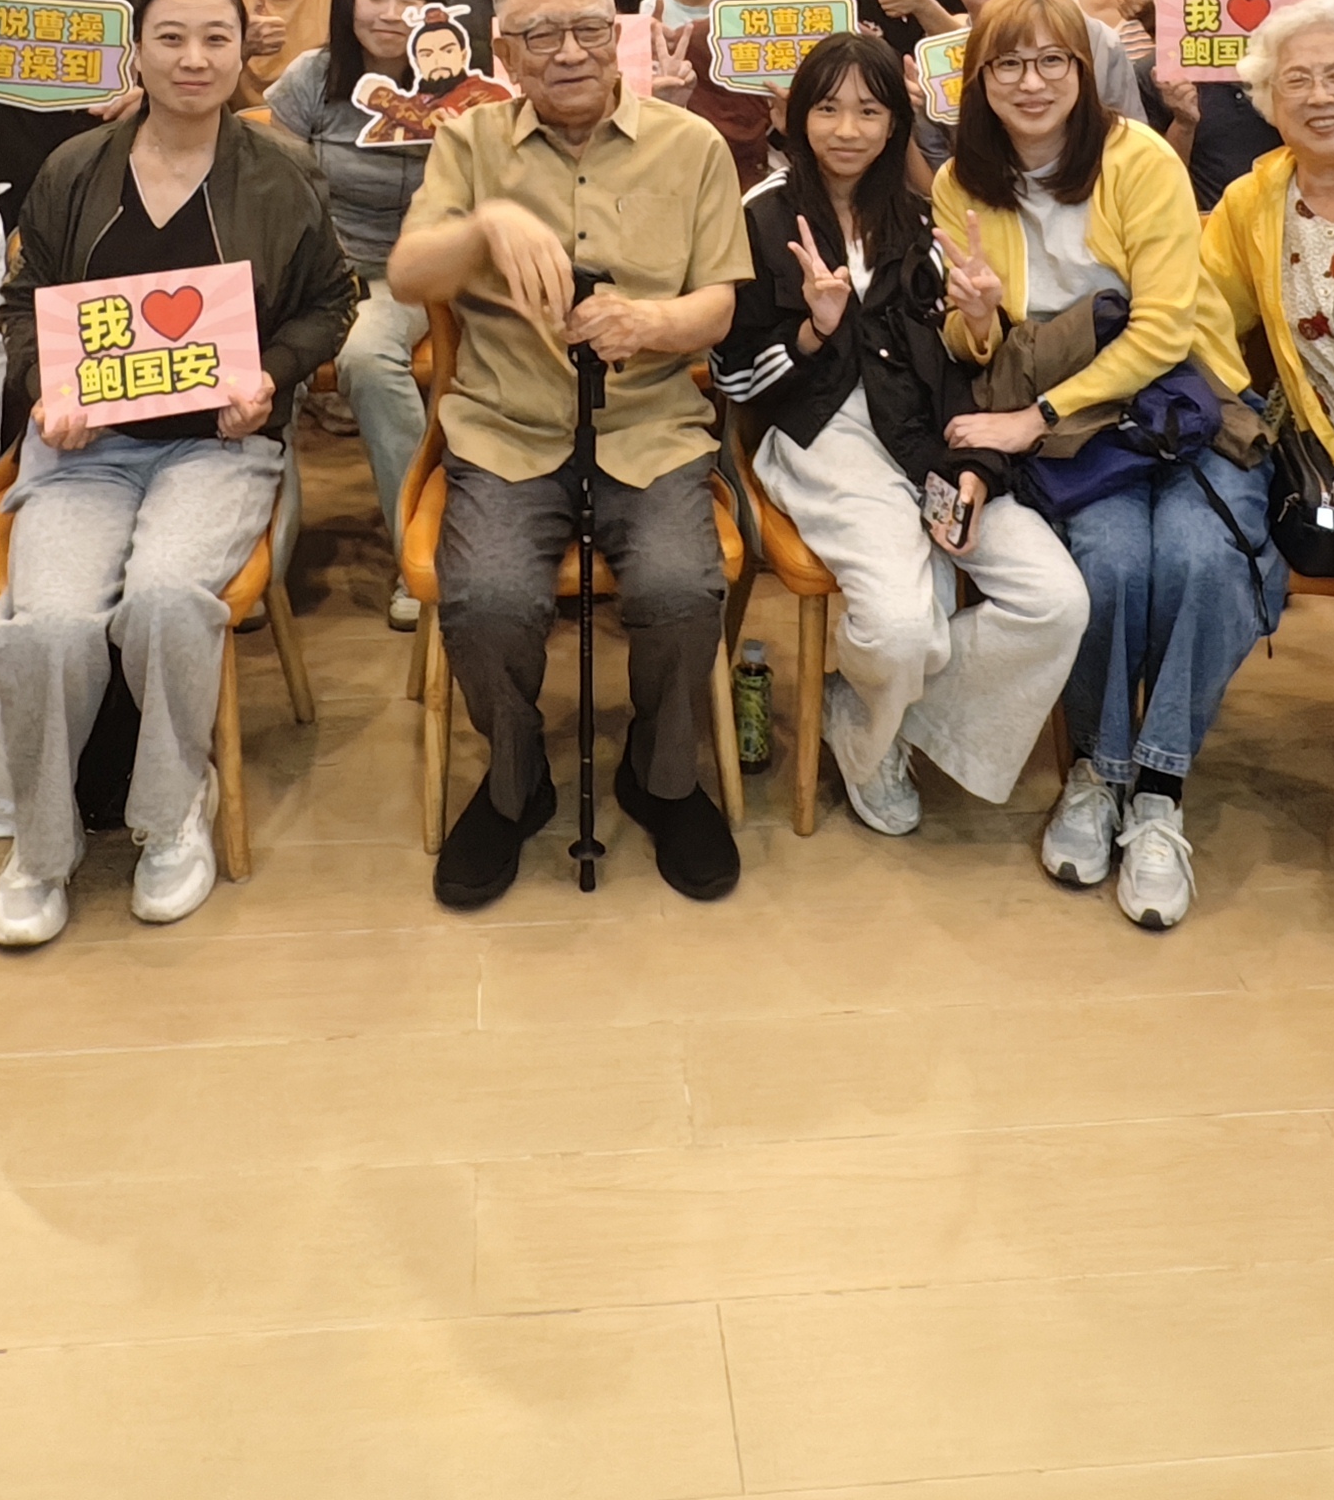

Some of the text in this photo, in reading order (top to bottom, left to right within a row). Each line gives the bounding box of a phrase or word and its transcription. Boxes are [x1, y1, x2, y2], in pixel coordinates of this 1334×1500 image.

[740, 5, 834, 36] 说曹操
[1180, 34, 1254, 68] 鲍国
[77, 295, 135, 355] 我
[76, 342, 219, 406] 鲍国安
